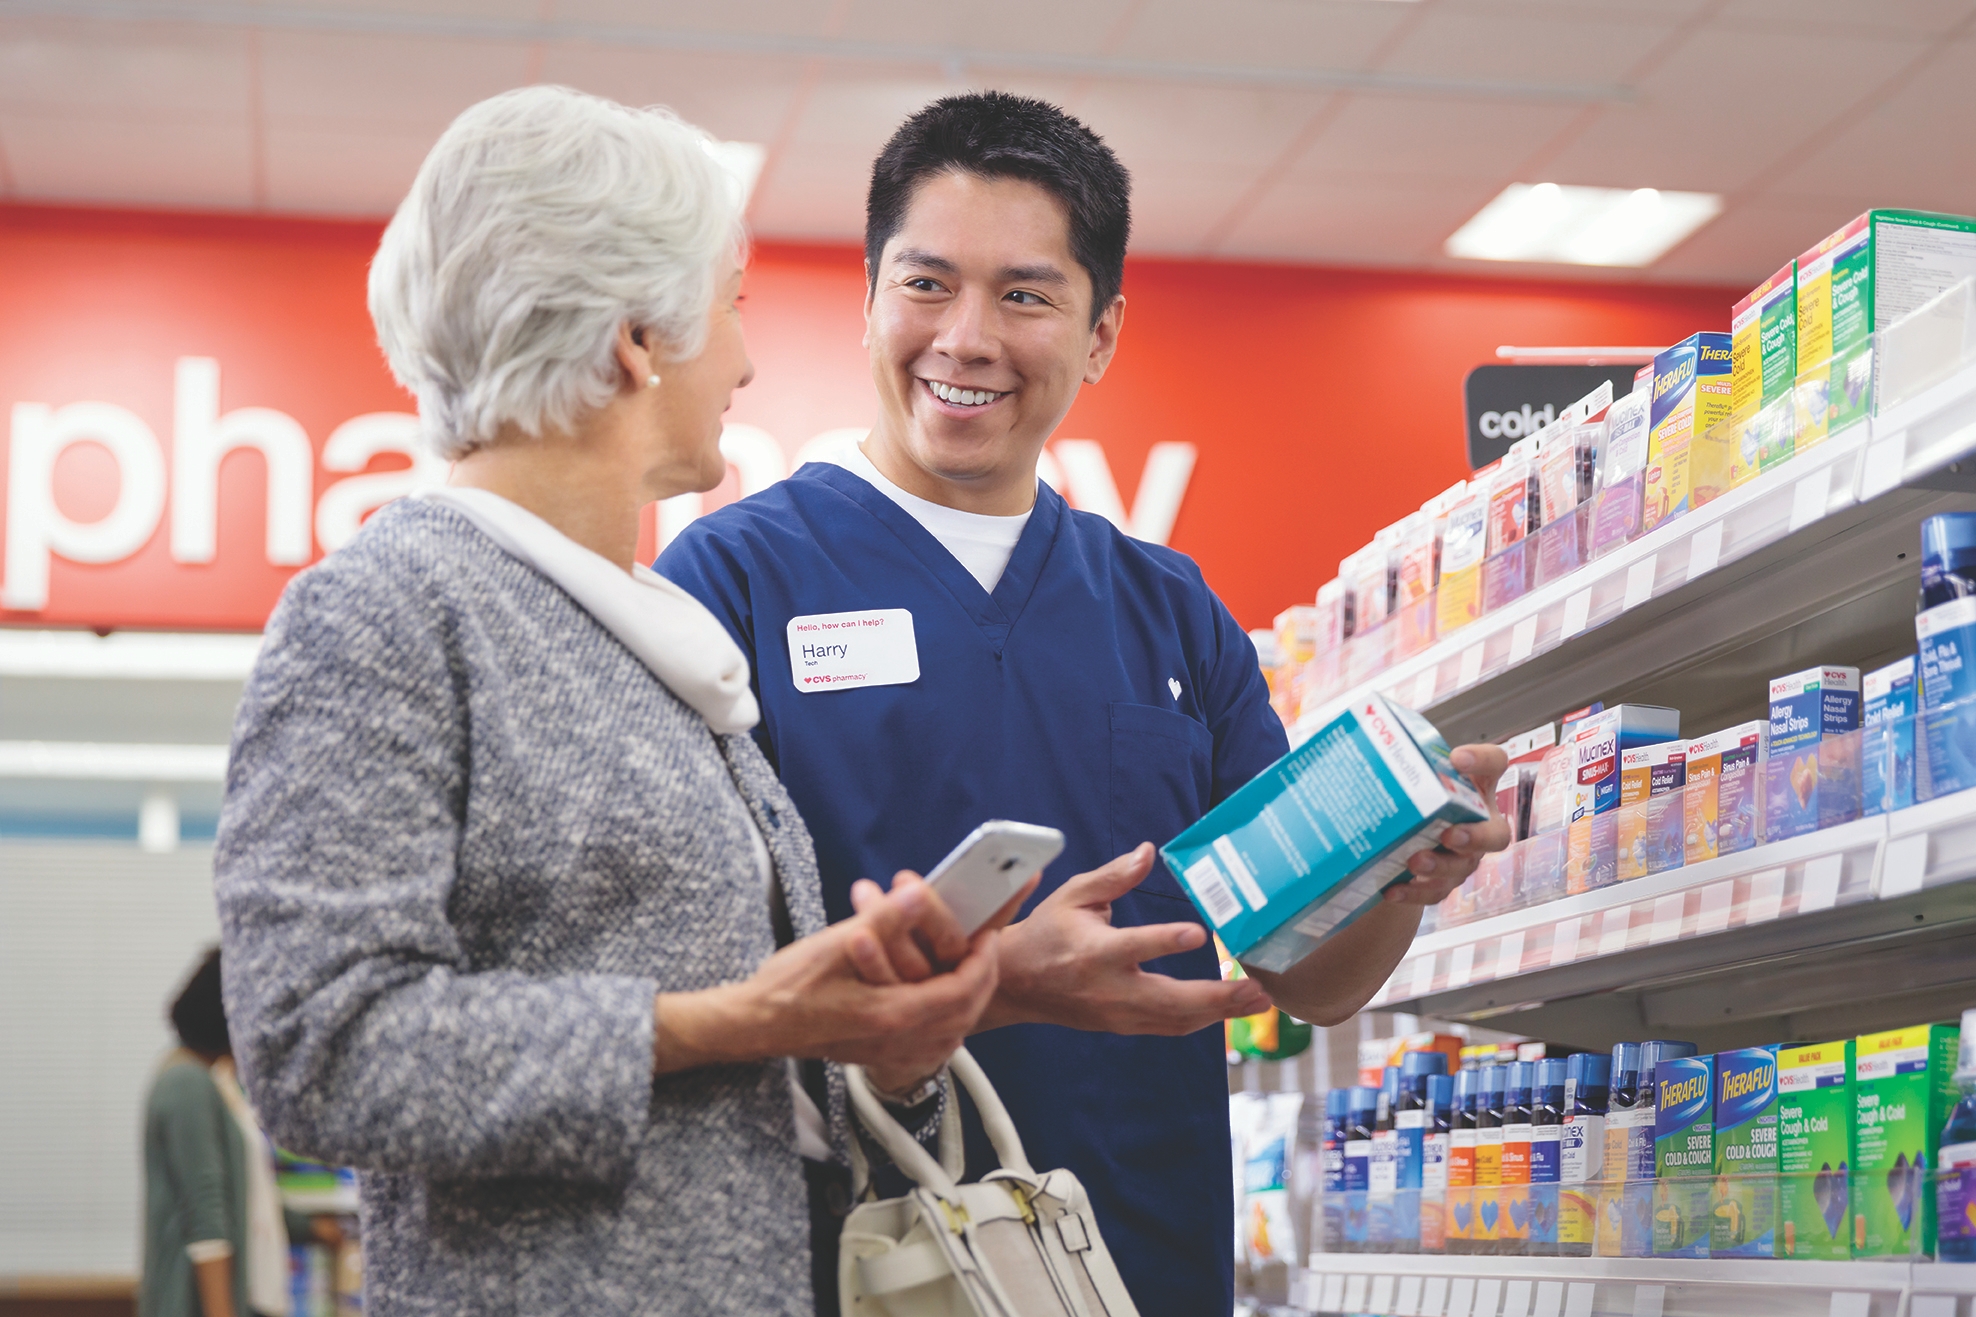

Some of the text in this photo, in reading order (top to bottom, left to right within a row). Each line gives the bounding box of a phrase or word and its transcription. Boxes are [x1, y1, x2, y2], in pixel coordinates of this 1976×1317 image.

[1832, 277, 1853, 298] Severe
[1837, 285, 1860, 306] Cough
[1798, 297, 1820, 318] Severe
[1798, 315, 1814, 332] Cold
[1761, 323, 1781, 343] Severe
[1766, 331, 1786, 352] Cough
[1732, 344, 1752, 361] Severe
[1732, 358, 1746, 377] Cold
[1653, 355, 1696, 404] THERAFLU
[1700, 384, 1732, 395] SEVERE
[1658, 423, 1678, 442] SEVERE
[1677, 415, 1693, 433] COLD
[797, 624, 820, 632] Hello,
[822, 622, 839, 630] how
[841, 621, 856, 629] can
[862, 618, 885, 628] help?
[802, 643, 848, 659] Harry
[813, 674, 866, 684] CVS pharmacy
[1824, 678, 1847, 687] Health
[1831, 671, 1847, 680] CVS
[1823, 695, 1853, 706] Allergy
[1823, 704, 1847, 713] Nasal
[1771, 705, 1793, 720] Allergy
[1823, 713, 1848, 724] Strips
[1864, 710, 1882, 728] Cold
[1882, 701, 1905, 721] Relief
[1771, 716, 1809, 737] Nasal Strips
[1723, 762, 1735, 774] Sinus
[1735, 758, 1746, 771] Pain
[1652, 774, 1674, 787] Cold Relief
[1688, 772, 1701, 783] Sinus
[1701, 768, 1711, 781] Pain
[1720, 768, 1746, 782] Congestion
[1600, 783, 1614, 796] NIGHT
[1622, 779, 1643, 791] Cold Relief
[1798, 1051, 1822, 1064] VALUE PACK
[1722, 1064, 1773, 1103] THERAFLU
[1660, 1073, 1707, 1112] THERAFLU
[1856, 1094, 1880, 1109] Severe
[1780, 1105, 1803, 1120] Severe
[1856, 1104, 1906, 1126] Cough & Cold
[1750, 1126, 1777, 1144] SEVERE
[1780, 1117, 1828, 1137] Cough & Cold
[1687, 1134, 1711, 1150] SEVERE
[1665, 1149, 1712, 1167] COLD & COUGH
[1725, 1144, 1745, 1161] COLD
[1744, 1144, 1751, 1159] &
[1751, 1142, 1777, 1158] COUGH
